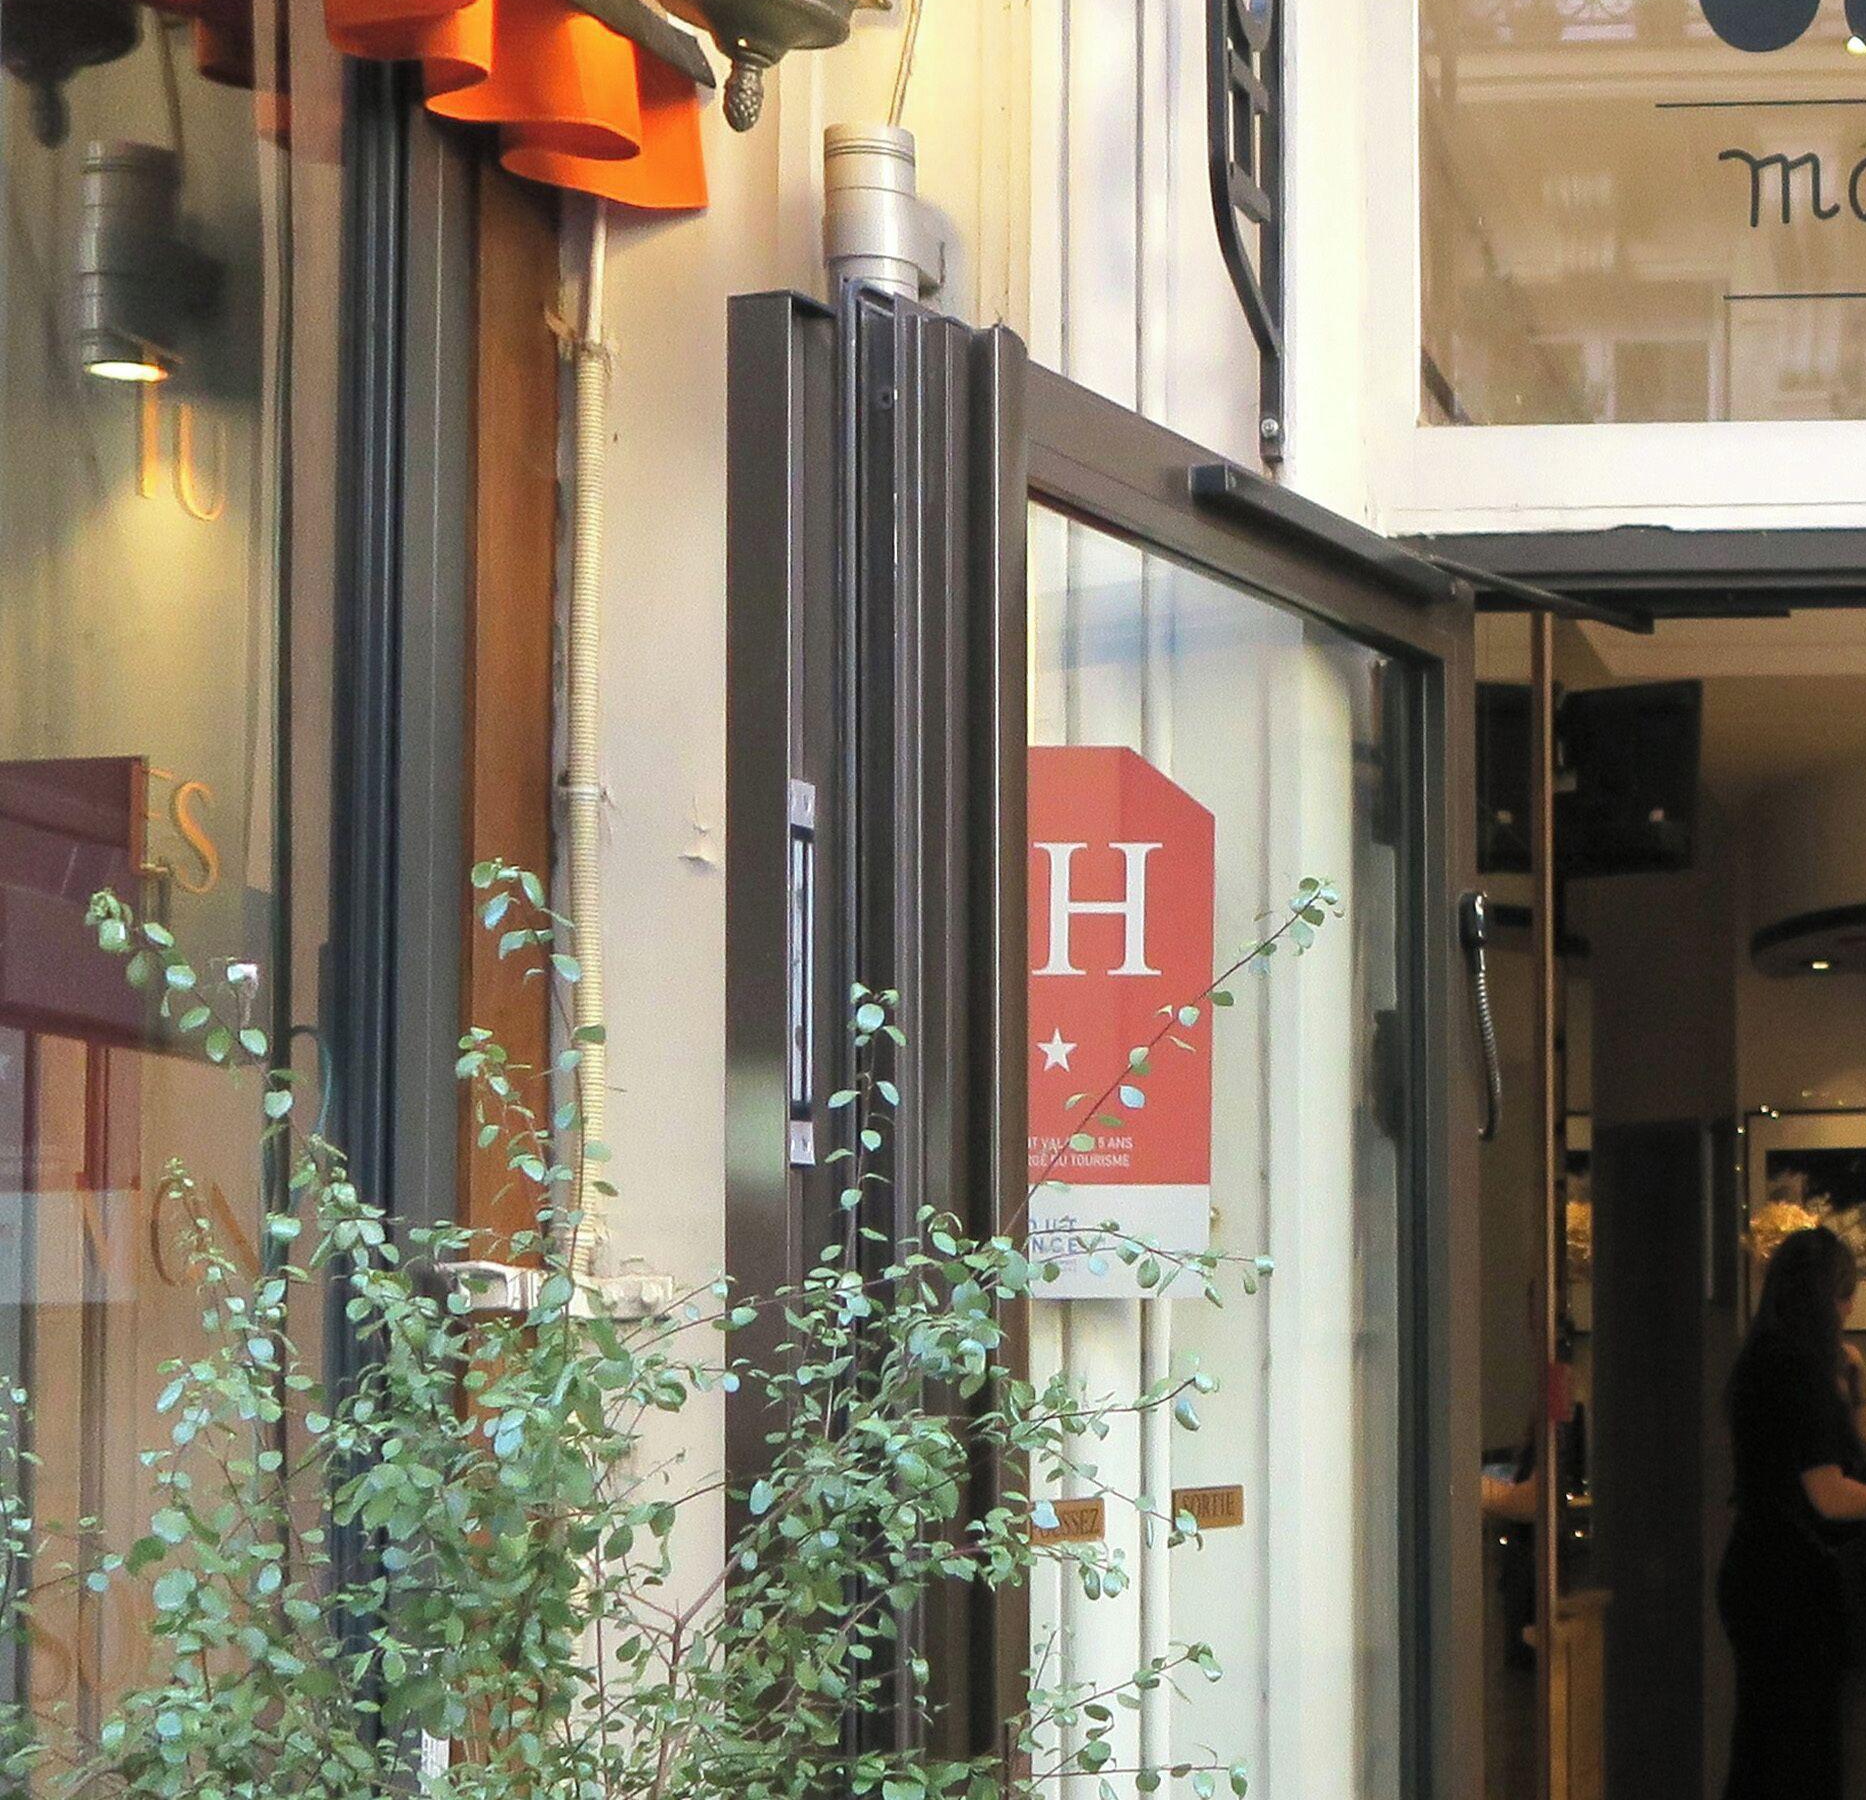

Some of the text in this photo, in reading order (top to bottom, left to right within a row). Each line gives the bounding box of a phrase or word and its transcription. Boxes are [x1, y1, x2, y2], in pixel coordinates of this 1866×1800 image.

[1032, 842, 1163, 976] H
[1107, 1136, 1134, 1149] ANS
[1071, 1153, 1131, 1167] TOURISME
